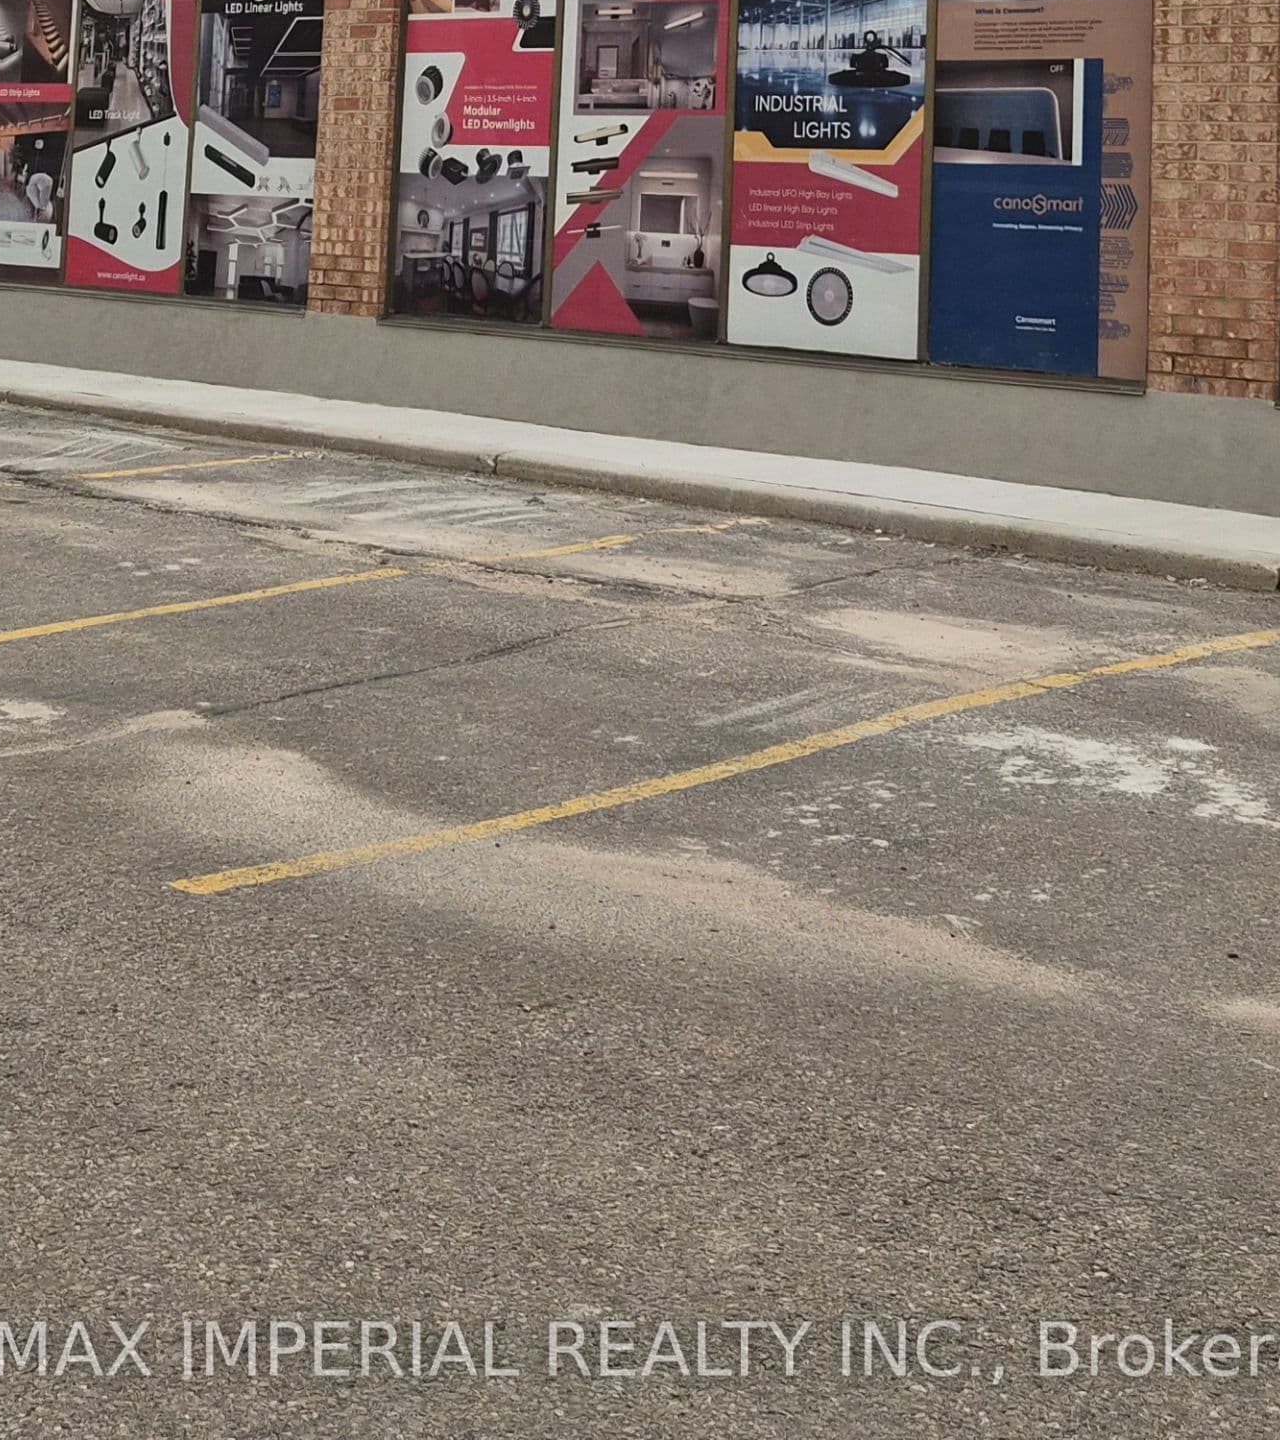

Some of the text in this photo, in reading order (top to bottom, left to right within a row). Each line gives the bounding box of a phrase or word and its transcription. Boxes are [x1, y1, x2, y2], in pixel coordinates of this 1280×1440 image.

[225, 0, 304, 15] LED Linear Lights
[1050, 64, 1065, 73] OFF
[755, 95, 848, 112] INDUSTRIAL
[89, 109, 103, 120] LED
[463, 105, 502, 116] Modular
[462, 118, 536, 132] LED Downlights
[793, 121, 852, 139] LIGHTS
[782, 188, 797, 198] UFO
[831, 190, 853, 201] Lights
[748, 203, 763, 212] LED
[780, 220, 795, 229] LED
